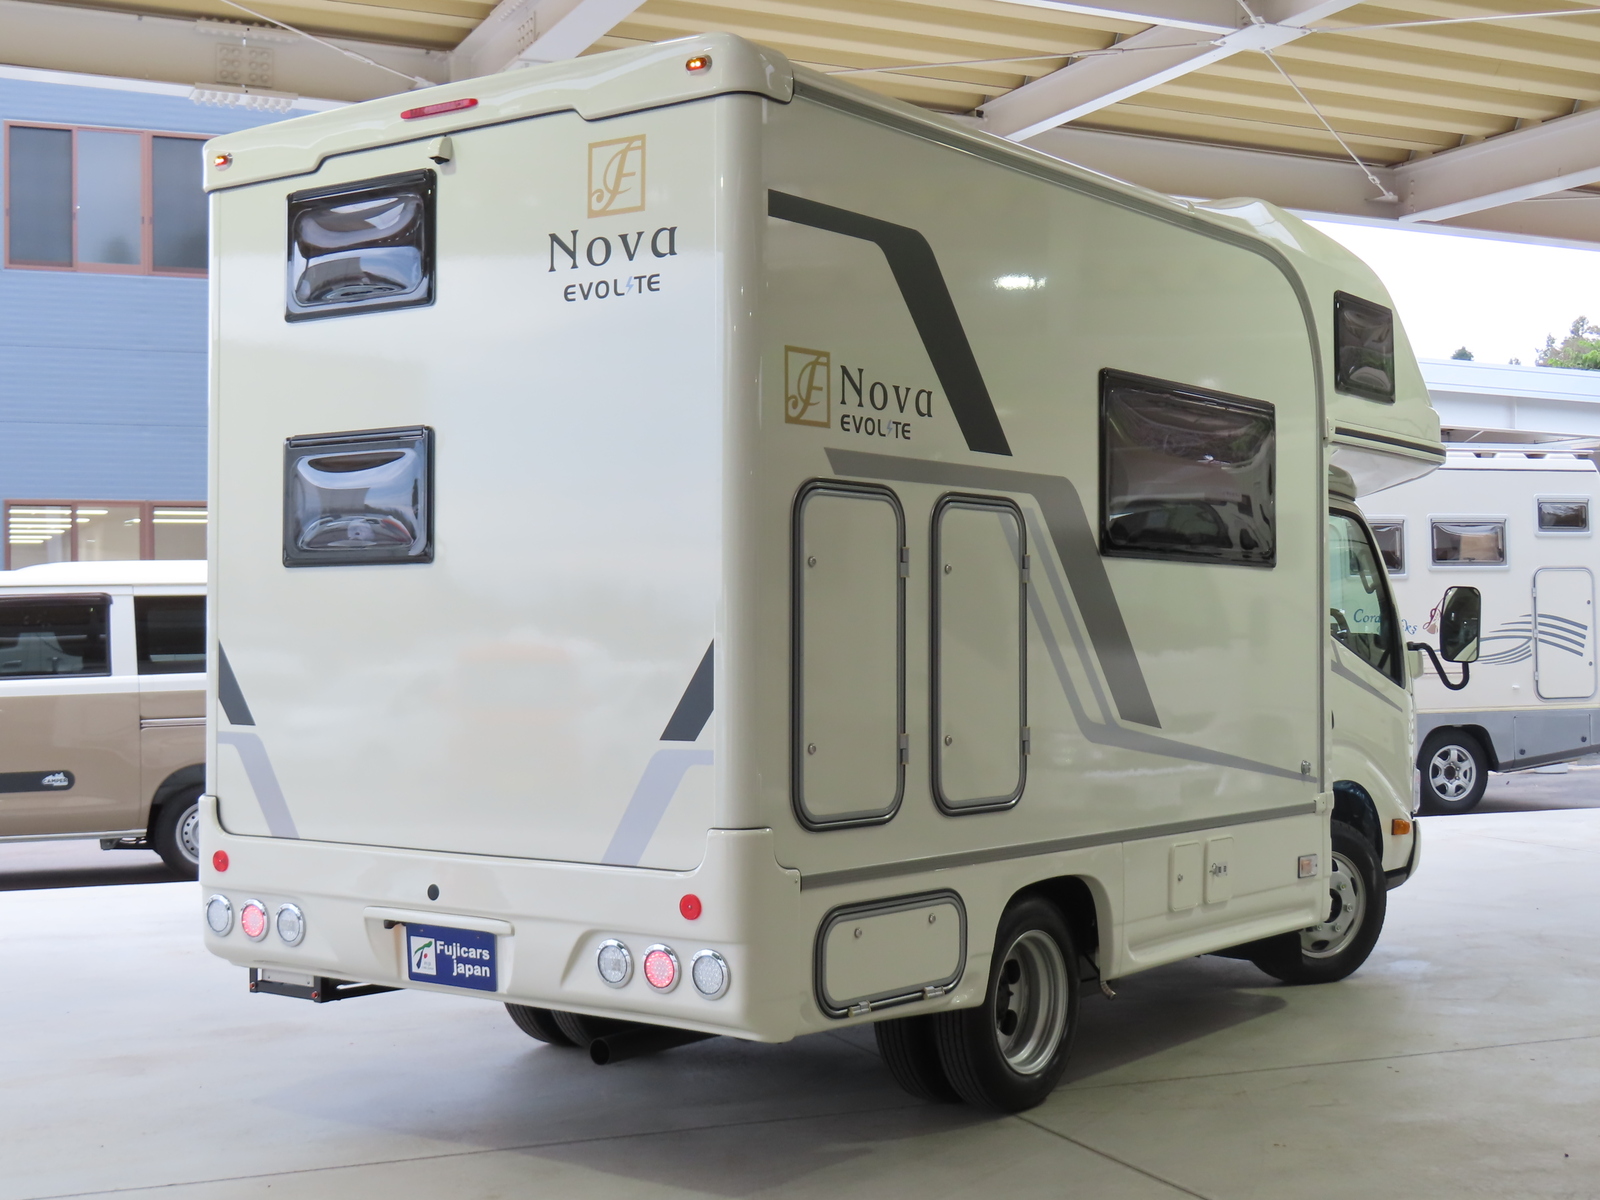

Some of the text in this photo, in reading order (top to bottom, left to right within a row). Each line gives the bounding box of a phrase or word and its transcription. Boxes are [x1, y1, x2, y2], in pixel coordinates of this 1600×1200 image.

[548, 226, 678, 272] Nova
[840, 364, 933, 418] Nova
[436, 940, 490, 960] Fujicars
[452, 959, 490, 978] japan
